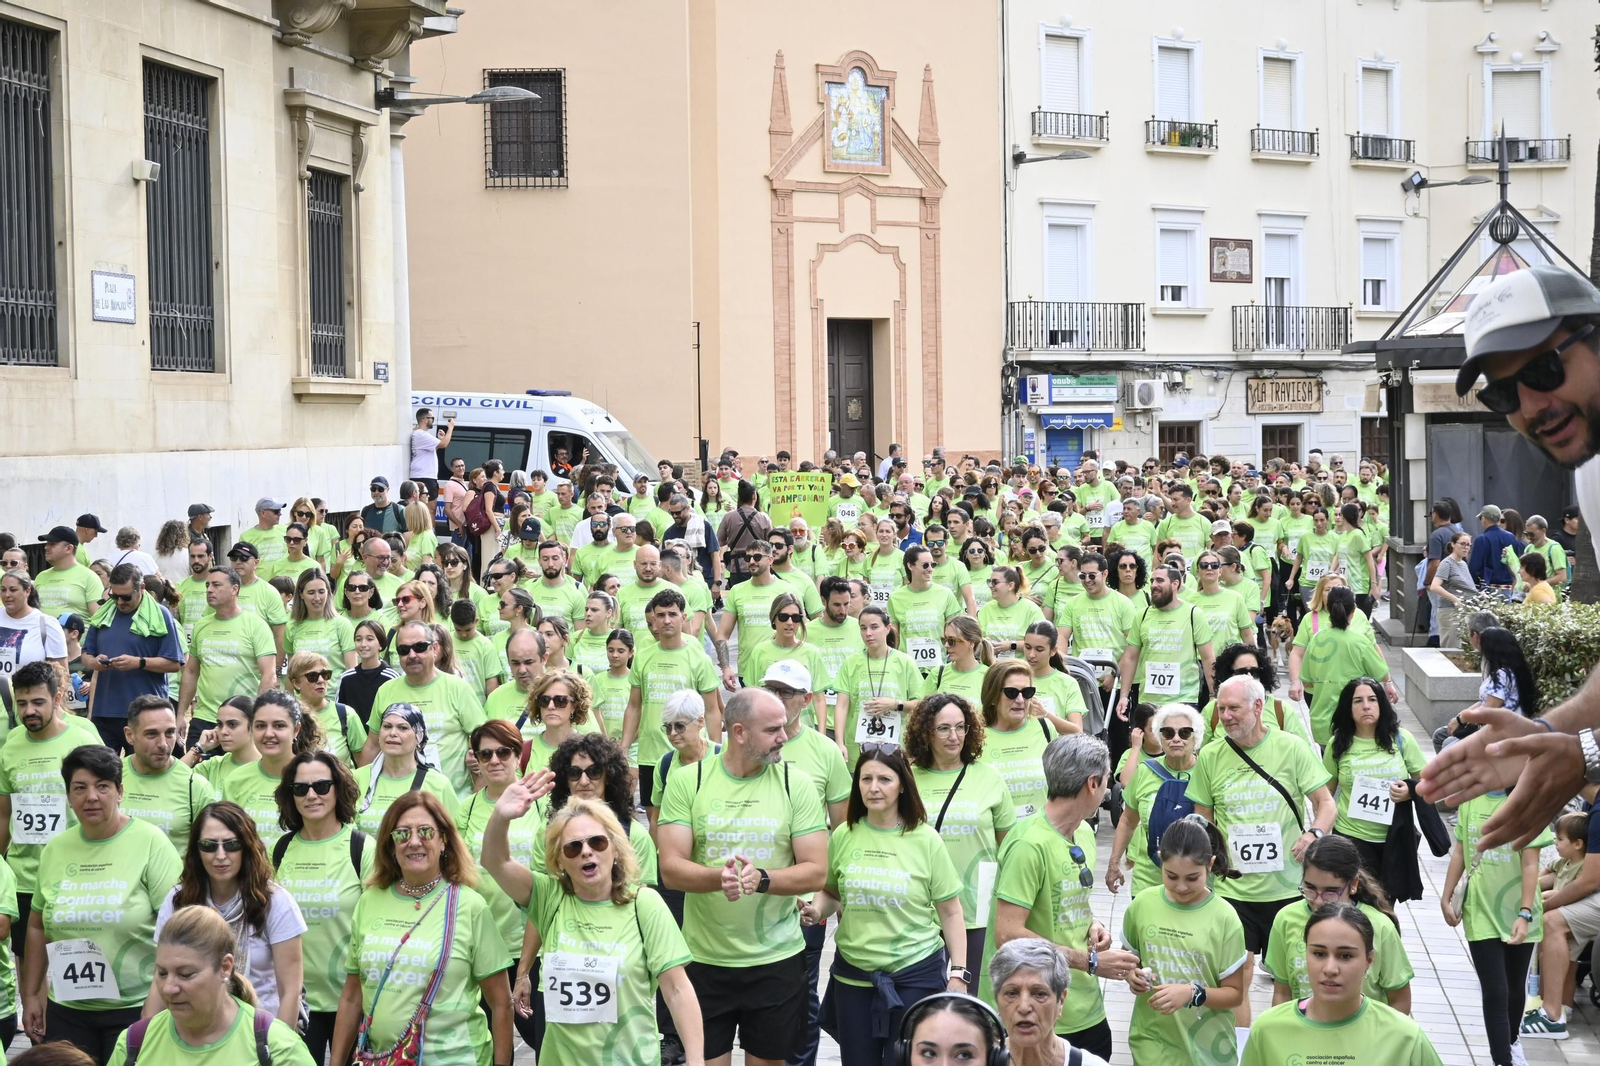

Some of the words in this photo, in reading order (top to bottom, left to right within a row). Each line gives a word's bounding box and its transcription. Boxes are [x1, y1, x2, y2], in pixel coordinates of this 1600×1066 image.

[1257, 382, 1267, 402] LA
[1270, 381, 1313, 402] TRAVIESA
[480, 398, 533, 409] CIVIL
[772, 475, 788, 483] ESTA
[772, 485, 781, 493] VA
[873, 591, 890, 601] 383
[912, 648, 936, 660] 708
[1150, 673, 1175, 686] 707
[1357, 793, 1390, 812] 441
[708, 814, 725, 826] En
[728, 814, 778, 827] marcha
[706, 829, 758, 843] contra
[761, 828, 776, 843] el
[706, 842, 775, 860] cáncer
[1232, 840, 1278, 862] 1673
[848, 863, 862, 874] En
[864, 866, 911, 879] marcha
[61, 879, 77, 891] En
[80, 876, 128, 891] marcha
[295, 877, 340, 888] marcha
[844, 876, 891, 892] contra
[893, 881, 908, 896] el
[56, 893, 106, 906] contra
[107, 892, 123, 905] el
[846, 889, 906, 908] cáncer
[53, 907, 124, 924] cáncer
[364, 934, 377, 944] En
[559, 932, 577, 948] En
[1145, 941, 1158, 954] En
[410, 952, 427, 967] el
[63, 961, 106, 984] 447
[549, 976, 611, 1006] 2539
